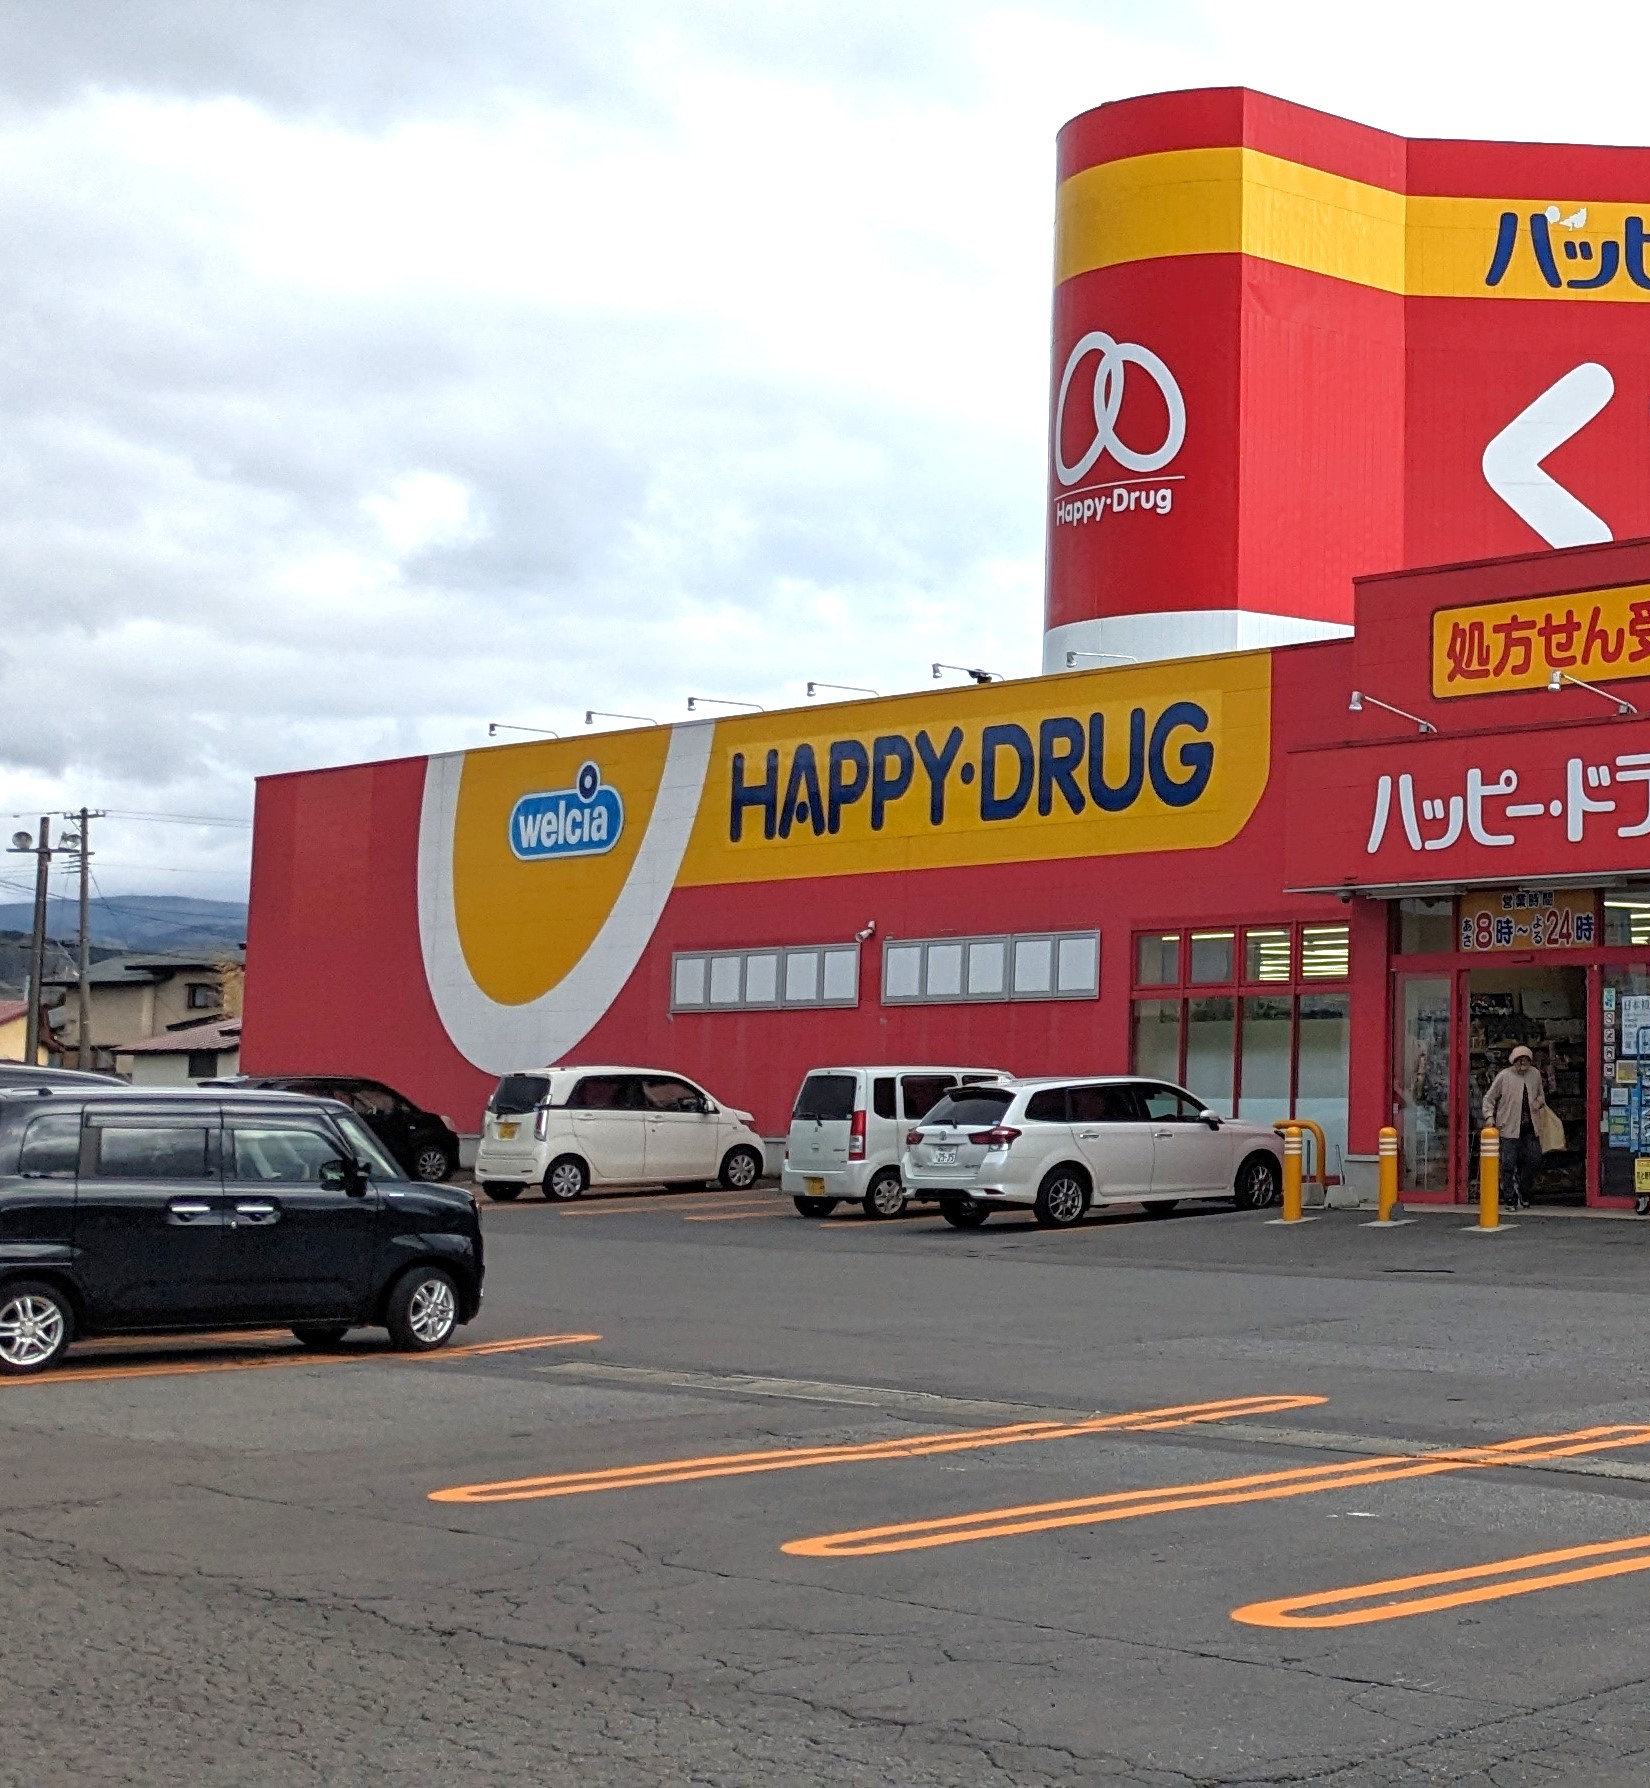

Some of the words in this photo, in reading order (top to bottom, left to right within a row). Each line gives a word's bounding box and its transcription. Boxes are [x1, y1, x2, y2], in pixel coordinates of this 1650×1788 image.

[519, 764, 608, 848] welcia
[1502, 890, 1554, 910] 営業時間
